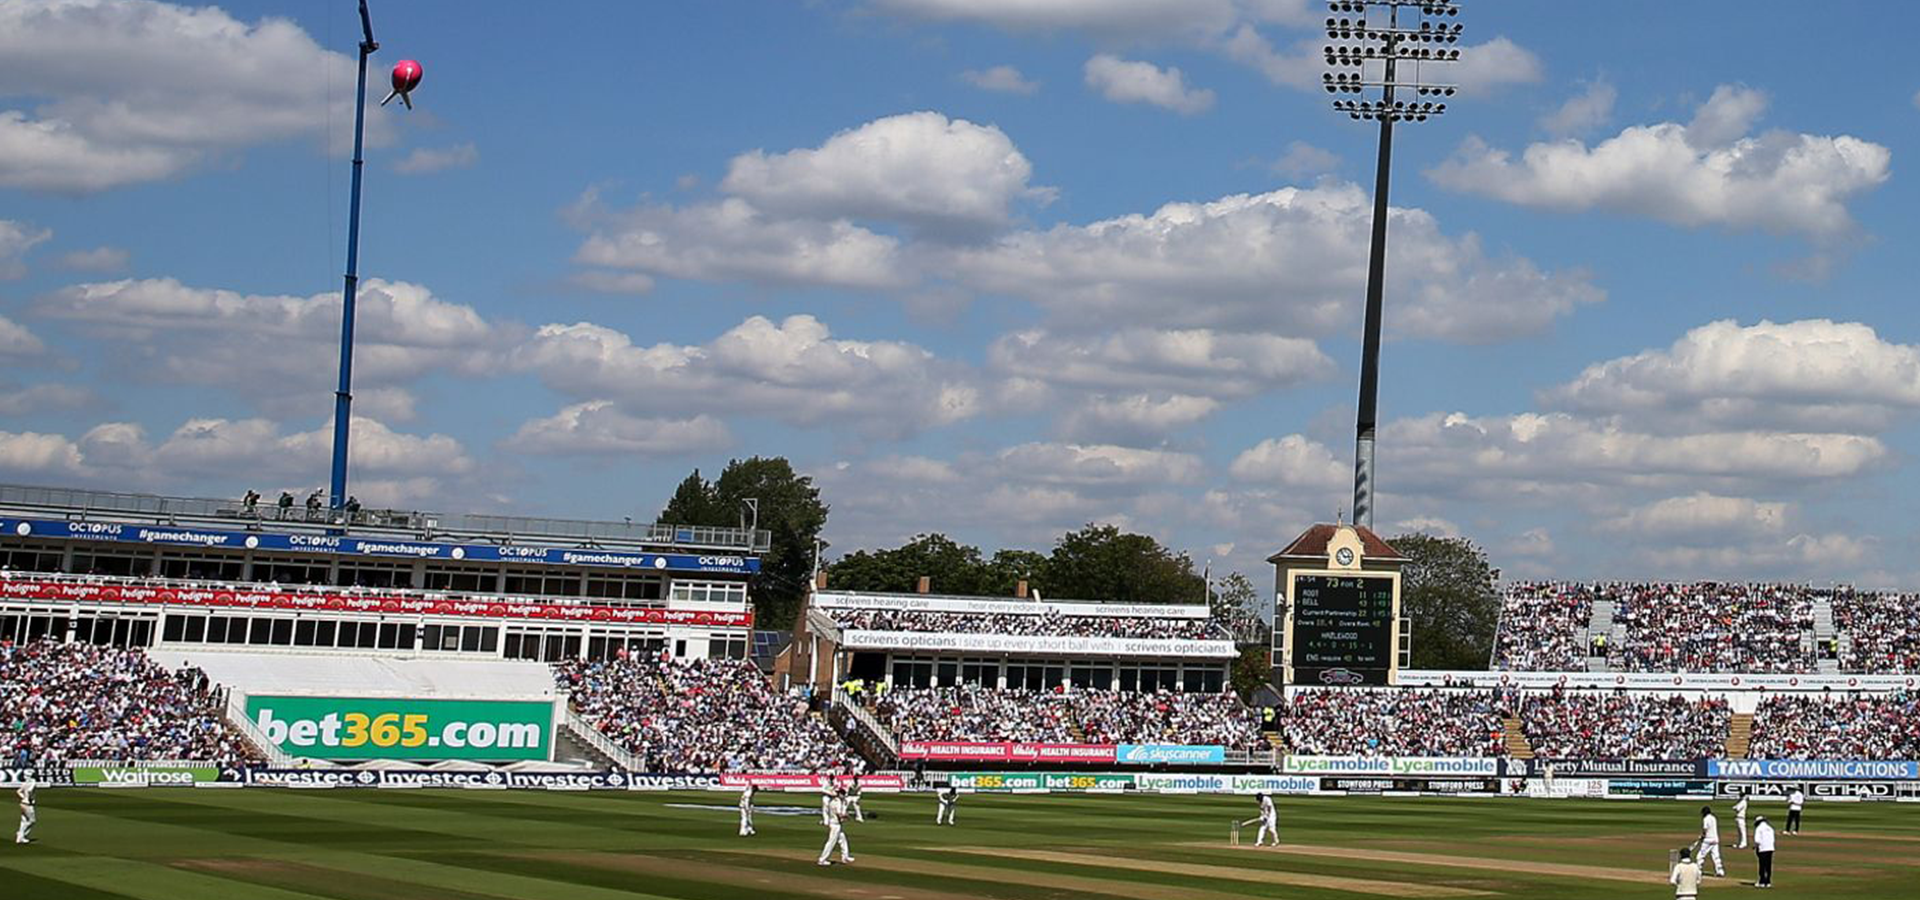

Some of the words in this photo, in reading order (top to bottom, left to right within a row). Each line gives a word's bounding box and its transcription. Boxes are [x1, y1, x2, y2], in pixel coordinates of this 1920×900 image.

[69, 522, 122, 535] OCTOPUS
[139, 529, 227, 545] #gamechanger
[289, 535, 340, 547] OCTOPUS
[356, 541, 440, 557] #gamechanger
[498, 547, 548, 558] OCTOPUS
[562, 552, 643, 566] #gamechanger
[698, 556, 745, 567] OCTOPUS
[2, 583, 41, 595] Pedigree
[1326, 577, 1339, 588] 73
[1357, 578, 1364, 589] 2
[62, 585, 99, 598] Pedigree
[120, 587, 156, 600] Pedigree
[178, 590, 214, 602] Pedigree
[1302, 589, 1319, 597] ROOT
[235, 593, 270, 605] Pedigree
[291, 595, 326, 607] Pedigree
[346, 598, 381, 609] Pedigree
[835, 597, 871, 605] scrivens
[874, 598, 908, 608] hearing
[910, 600, 930, 608] care
[1302, 598, 1319, 606] BELL
[400, 600, 434, 611] Pedigree
[454, 602, 487, 613] Pedigree
[507, 604, 541, 616] Pedigree
[560, 606, 593, 617] Pedigree
[1095, 605, 1130, 614] scrivens
[1132, 606, 1165, 616] hearing
[1167, 607, 1186, 615] care
[612, 609, 645, 620] Pedigree
[663, 611, 695, 622] Pedigree
[713, 613, 745, 624] Pedigree
[851, 633, 899, 645] scrivens
[901, 634, 957, 649] opticians
[964, 636, 985, 646] size
[987, 638, 1002, 649] up
[1004, 639, 1035, 652] every
[1038, 638, 1066, 650] short
[1068, 639, 1089, 651] ball
[1091, 640, 1115, 651] with
[1124, 642, 1172, 653] scrivens
[1174, 643, 1227, 657] opticians
[258, 709, 540, 748] bet365.com
[930, 746, 960, 755] HEALTH
[961, 746, 1006, 756] INSURANCE
[1040, 747, 1070, 756] HEALTH
[1070, 748, 1115, 757] INSURANCE
[1150, 747, 1213, 760] skyscanner
[1286, 756, 1389, 773] Lycamobile
[1392, 758, 1495, 774] Lycamobile
[1581, 760, 1626, 772] Mutual
[1629, 760, 1696, 773] Insurance
[1717, 762, 1763, 776] TATA
[1767, 762, 1909, 777] COMMUNICATIONS
[38, 768, 71, 776] ESTD
[102, 768, 194, 784] Waitrose
[245, 767, 353, 784] Investec
[378, 770, 482, 786] Investec
[506, 772, 604, 787] Investec
[628, 772, 721, 788] Investec
[951, 775, 1037, 788] bet365.com
[1046, 776, 1131, 788] bet365.com
[1139, 775, 1223, 790] Lycamobile
[1232, 776, 1316, 791] Lycamobile
[1337, 780, 1372, 789] STOWFORD
[1372, 780, 1394, 789] PRESS
[1428, 781, 1463, 790] STOWFORD
[1464, 781, 1485, 790] PRESS
[1587, 780, 1603, 790] 125
[1814, 784, 1889, 796] ETIHAD
